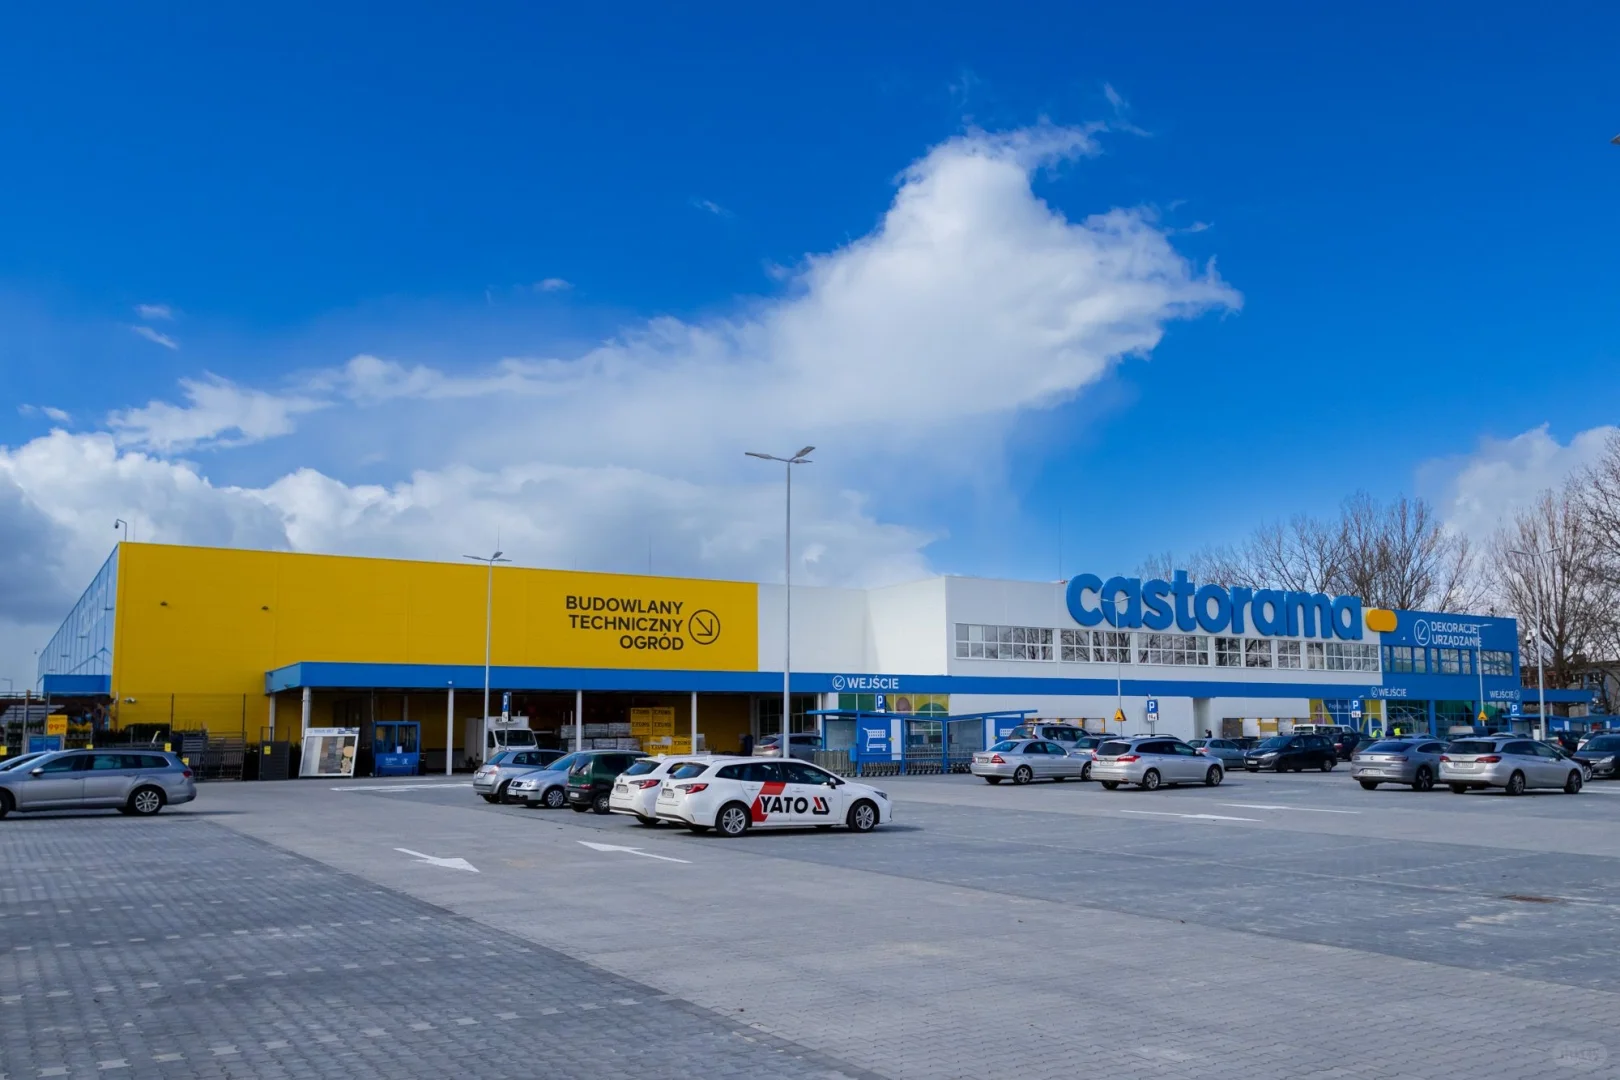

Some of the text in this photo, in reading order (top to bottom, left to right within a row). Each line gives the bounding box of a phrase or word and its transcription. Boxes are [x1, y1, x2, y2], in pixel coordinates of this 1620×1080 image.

[565, 595, 684, 615] BUDOWLANY
[1066, 570, 1363, 640] castorama
[568, 614, 684, 633] TECHNICZNY
[1431, 621, 1478, 634] DEKORACJE
[619, 632, 684, 651] OGRÓD
[1431, 635, 1482, 648] URZĄDZANIE
[846, 675, 900, 690] WEJŚCIE
[1378, 686, 1407, 697] WEJŚCIE
[1489, 689, 1514, 699] WEJŚCIE
[877, 695, 883, 707] P
[1149, 701, 1155, 712] P
[1352, 700, 1359, 710] P
[1512, 704, 1518, 713] P
[760, 796, 809, 814] YATO
